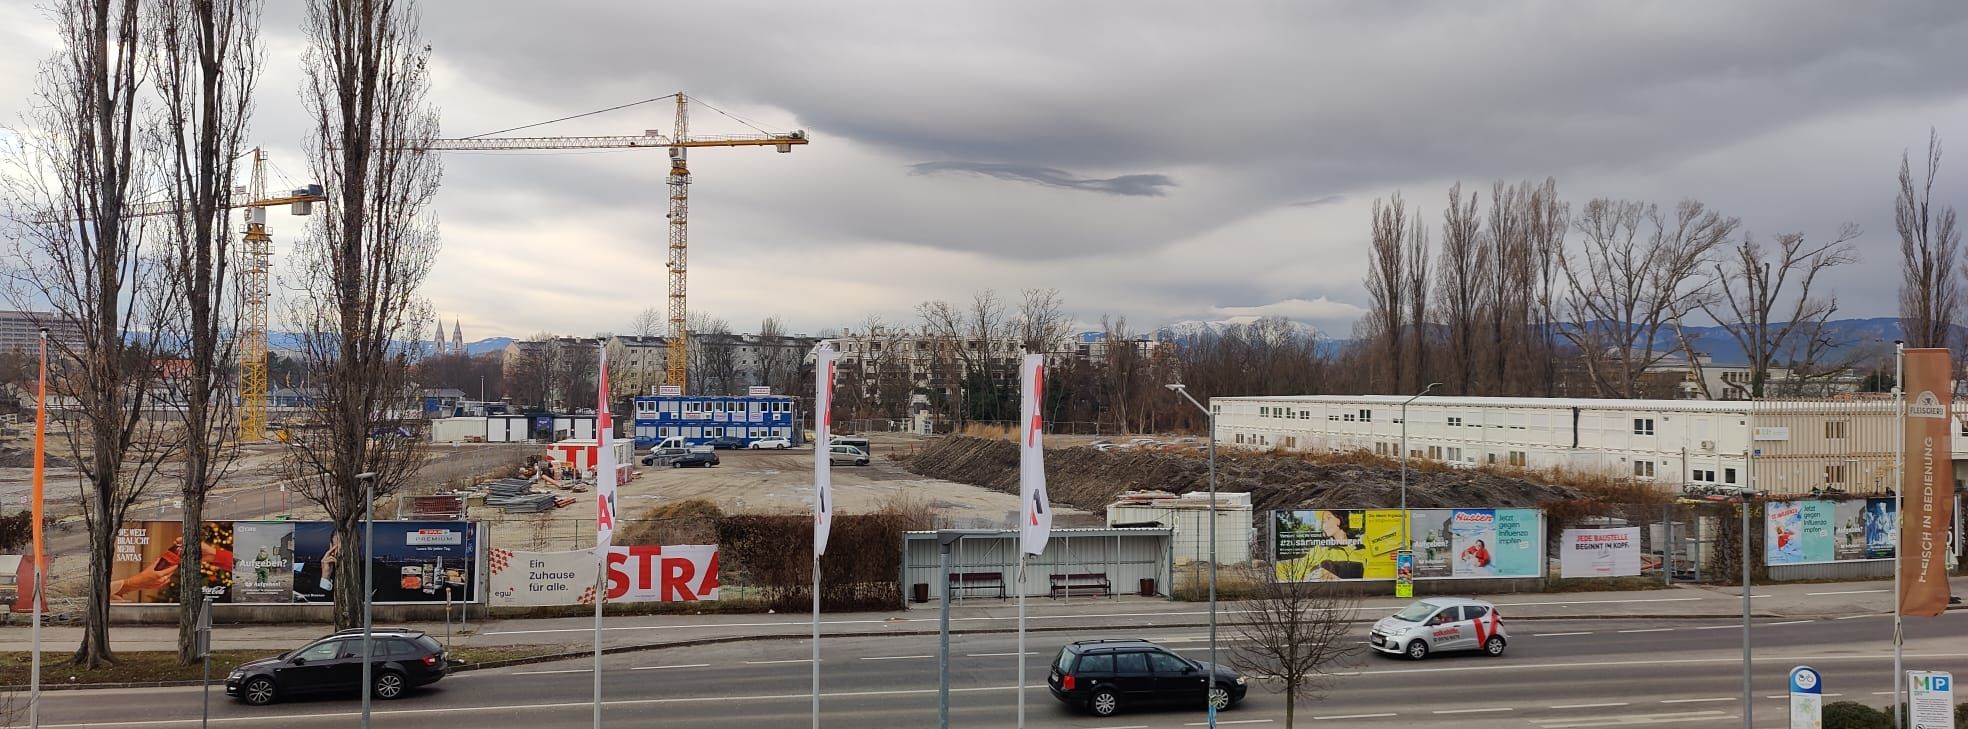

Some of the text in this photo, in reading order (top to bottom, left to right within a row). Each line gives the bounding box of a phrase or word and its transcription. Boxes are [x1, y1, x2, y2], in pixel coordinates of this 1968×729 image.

[1924, 436, 1934, 512] BEDIENUNG
[1923, 515, 1932, 529] IN
[129, 529, 147, 537] WELT
[117, 537, 150, 545] BRAUCHT
[117, 545, 136, 553] MEHR
[116, 554, 142, 562] SANTAS
[239, 559, 288, 569] Aufgeben?
[529, 560, 545, 568] Ein
[529, 570, 576, 580] Zuhause
[529, 582, 569, 592] für alle.
